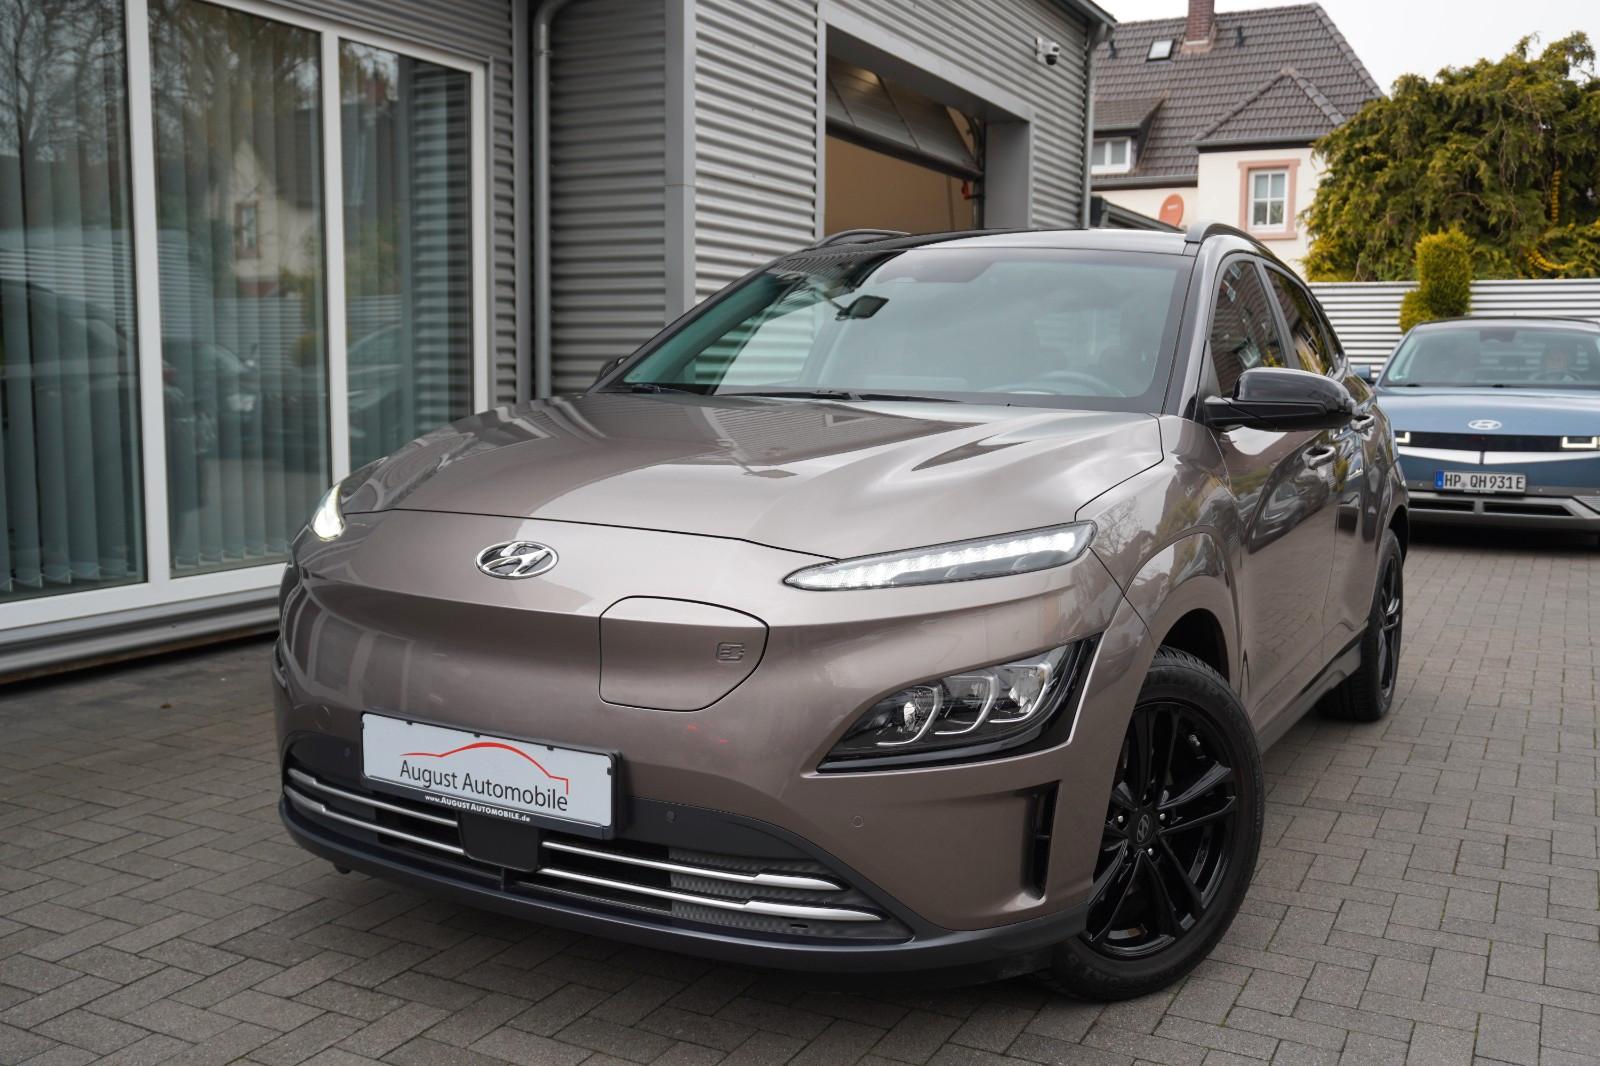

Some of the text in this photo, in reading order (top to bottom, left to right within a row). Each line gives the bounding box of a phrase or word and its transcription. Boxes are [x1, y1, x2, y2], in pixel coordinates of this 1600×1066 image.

[1444, 474, 1462, 487] HP
[400, 759, 568, 811] August Automobile
